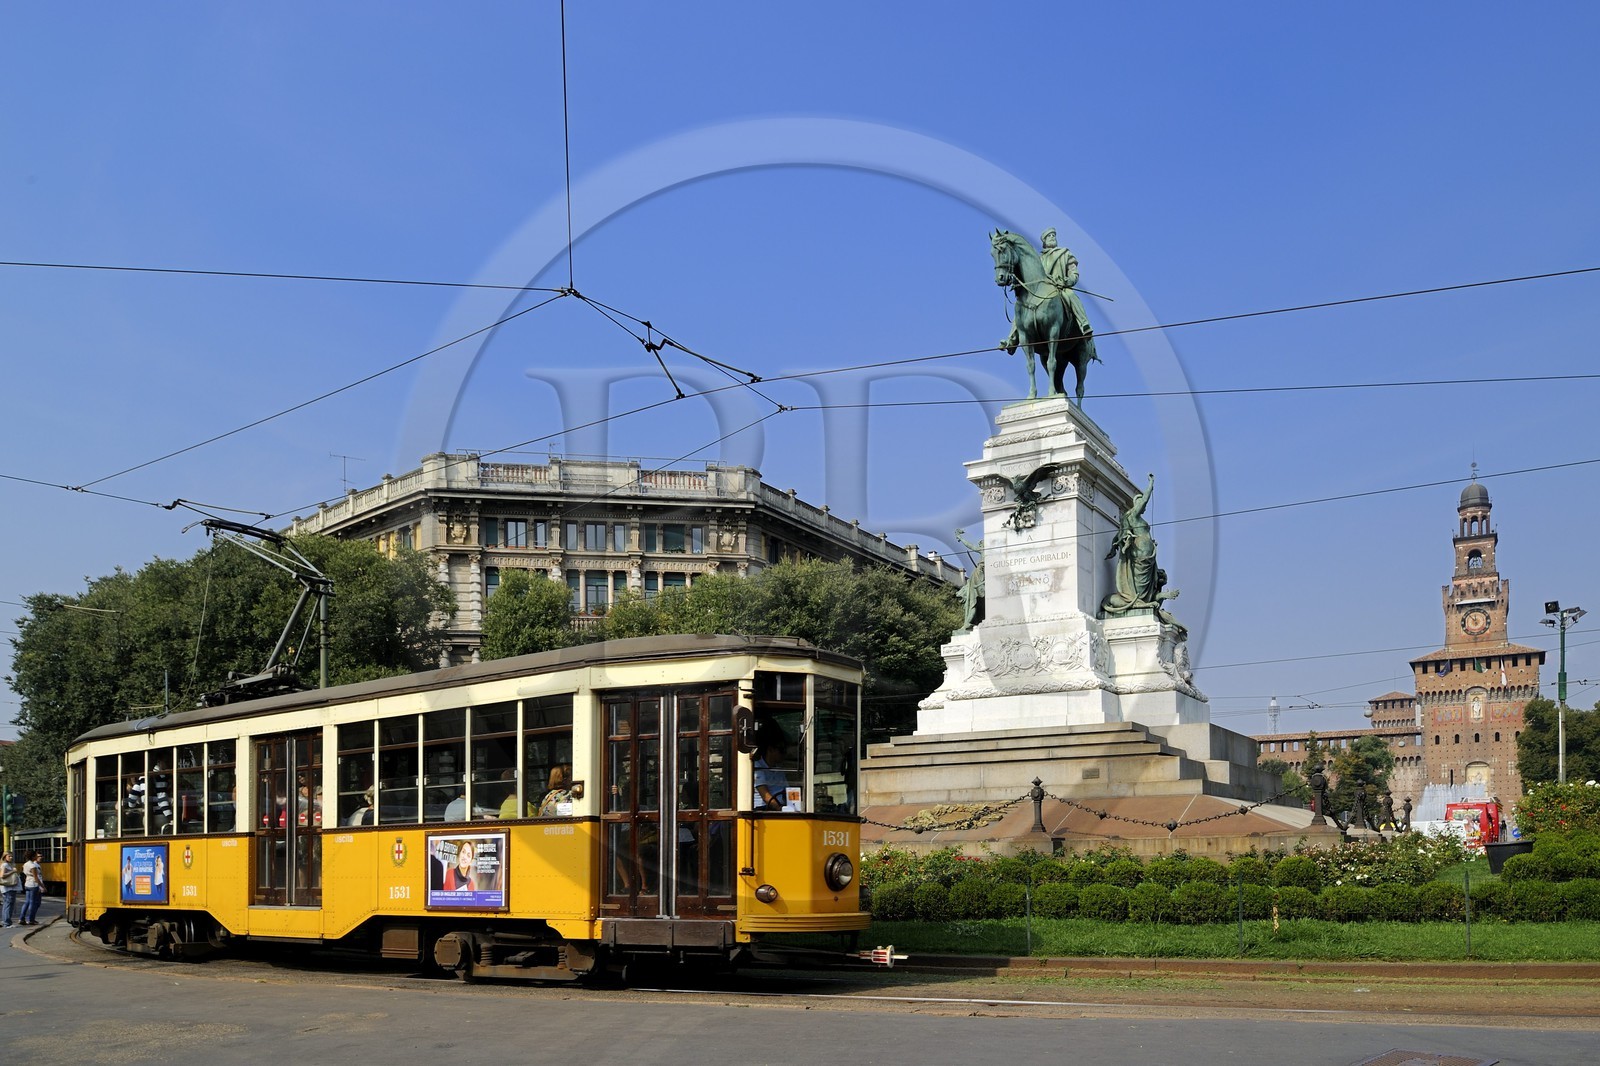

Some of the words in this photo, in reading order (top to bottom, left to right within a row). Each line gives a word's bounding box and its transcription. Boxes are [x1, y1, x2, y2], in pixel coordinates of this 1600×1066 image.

[1026, 534, 1033, 542] A
[544, 826, 574, 835] entrata
[823, 830, 849, 847] 1531
[182, 885, 197, 897] 1531
[389, 885, 411, 899] 1531
